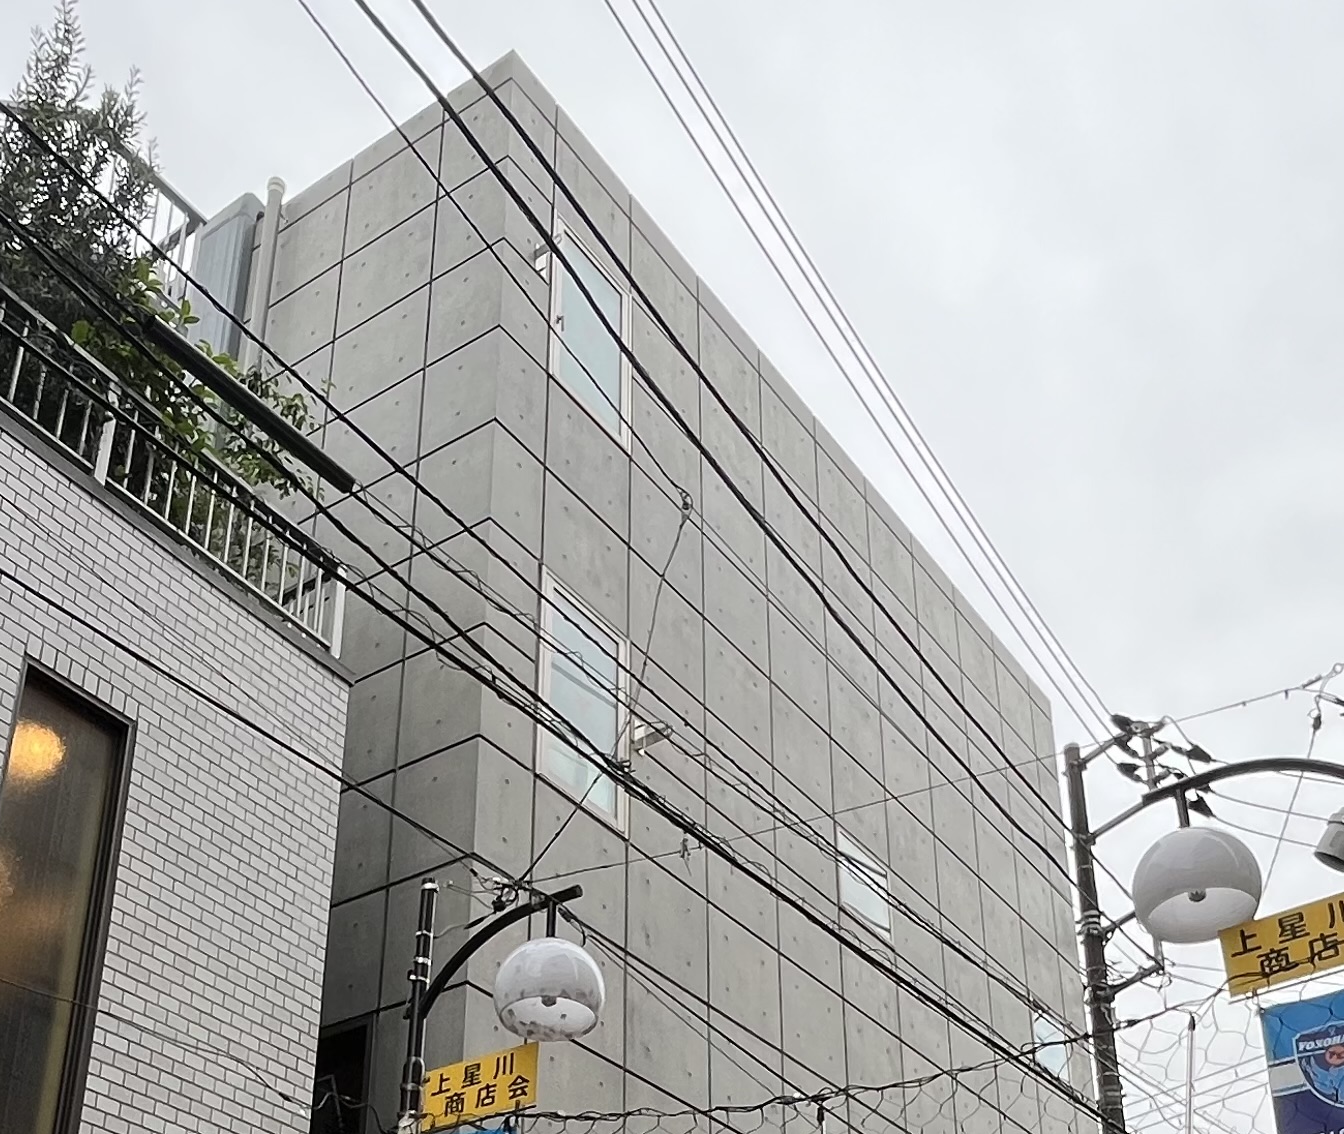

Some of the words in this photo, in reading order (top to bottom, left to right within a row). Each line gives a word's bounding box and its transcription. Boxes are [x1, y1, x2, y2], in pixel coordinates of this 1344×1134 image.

[430, 1052, 516, 1097] 上星川
[444, 1075, 529, 1117] 商店会
